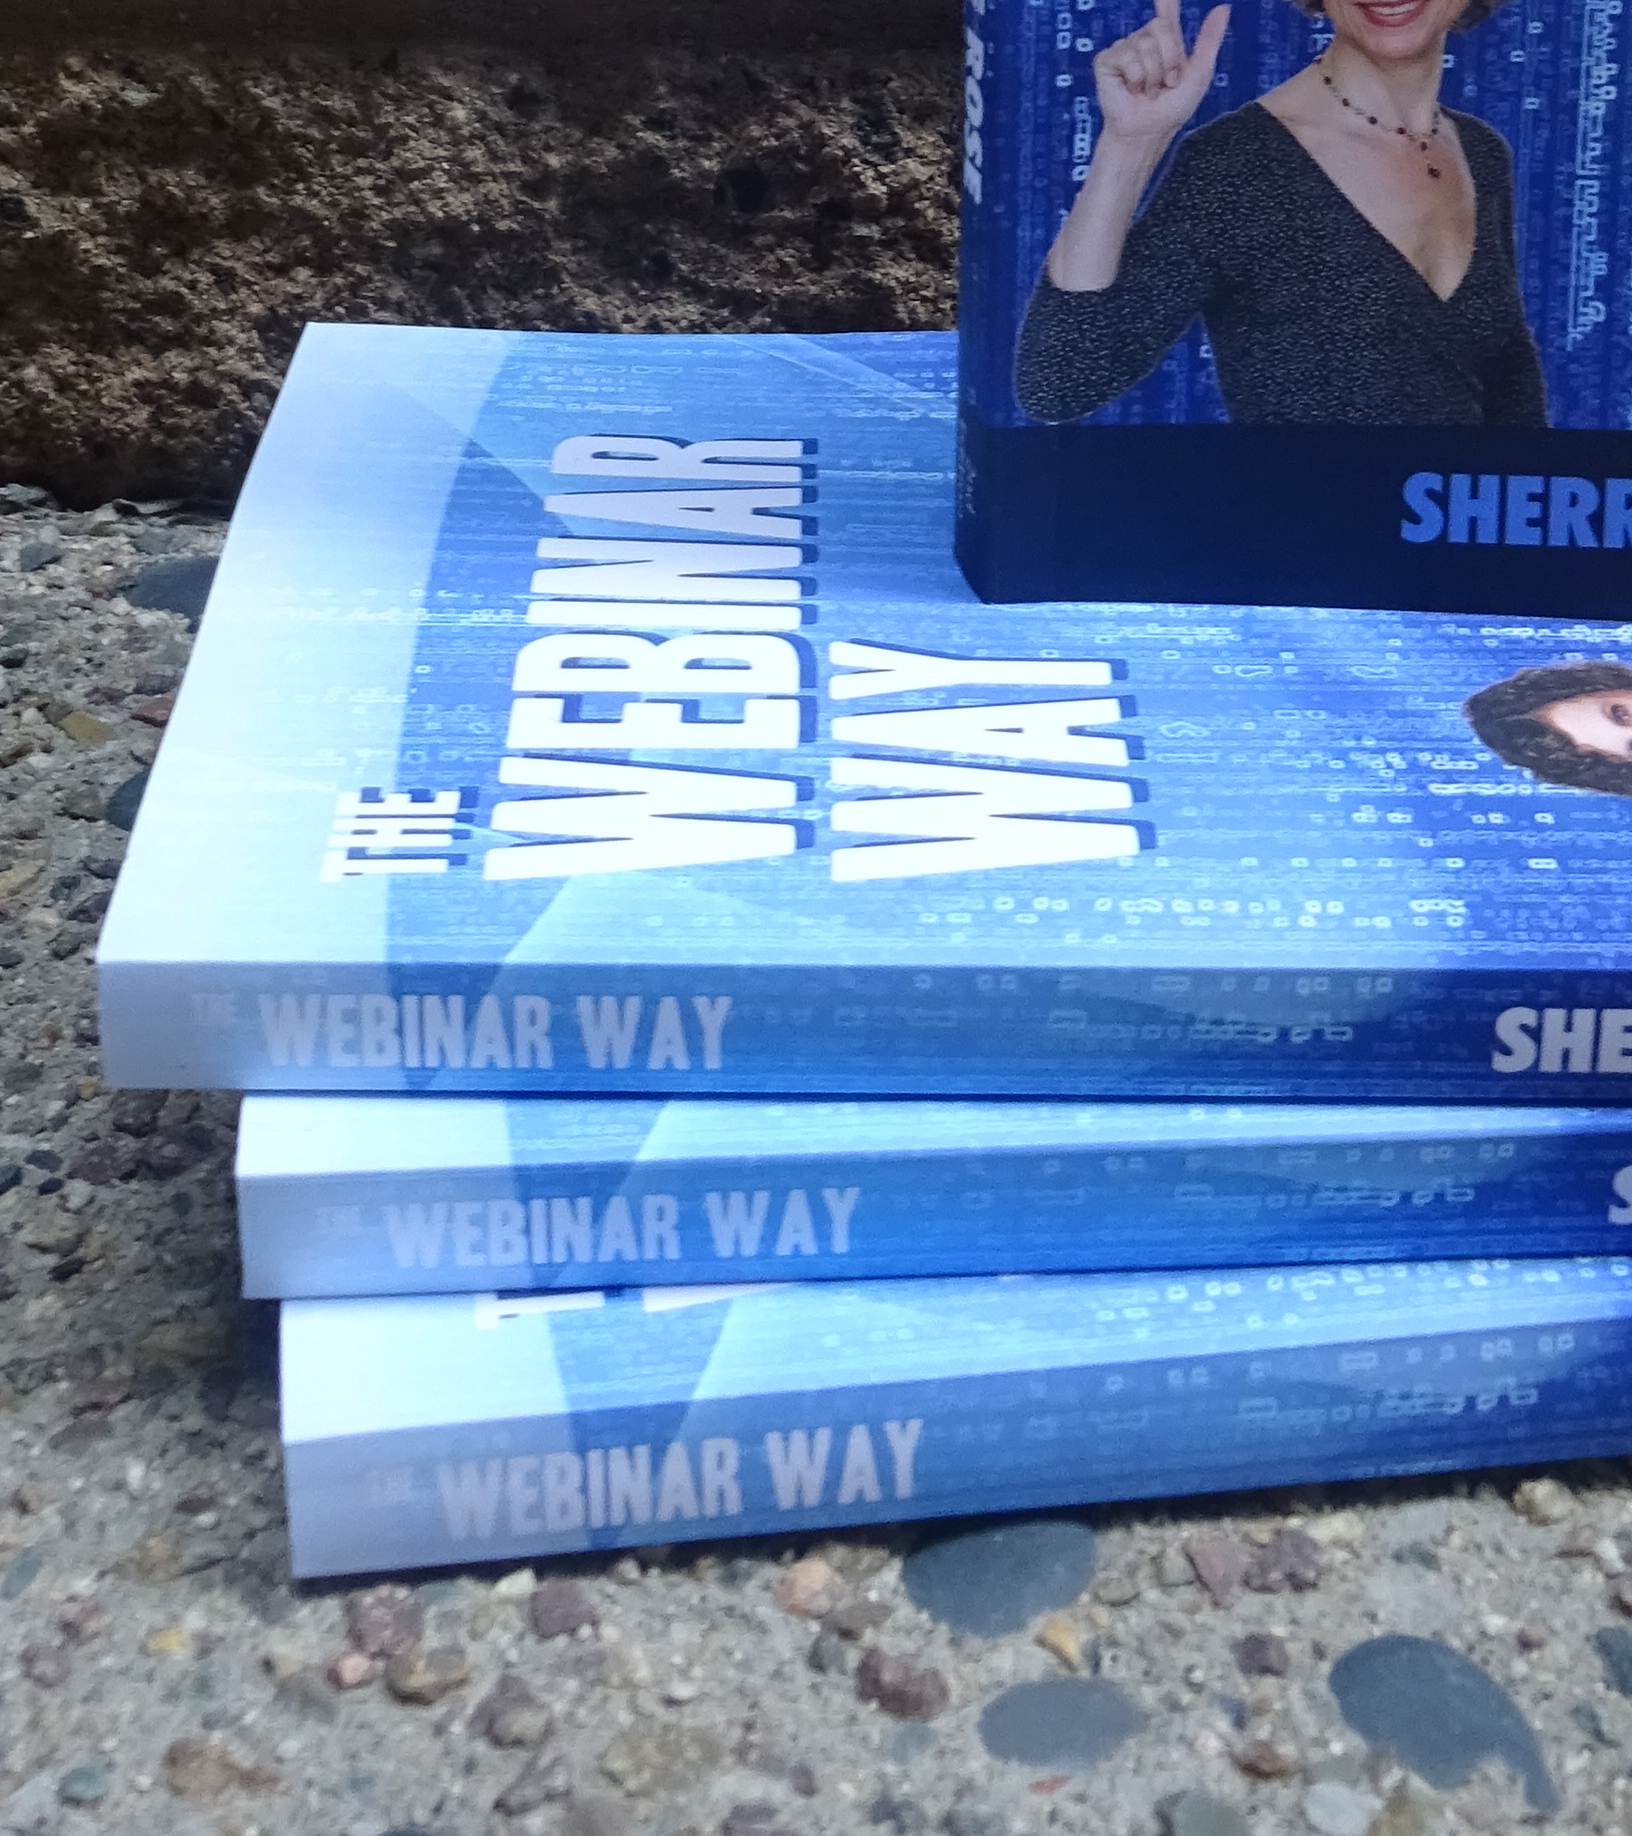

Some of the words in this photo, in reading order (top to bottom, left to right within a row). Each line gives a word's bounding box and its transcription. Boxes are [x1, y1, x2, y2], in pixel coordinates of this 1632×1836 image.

[964, 28, 985, 205] ROSE
[483, 433, 805, 881] WEBINAR
[829, 638, 1142, 883] WAY
[319, 786, 461, 883] THE
[257, 992, 554, 1070] WEBINAR
[576, 994, 735, 1071] WAY
[383, 1193, 682, 1270] WEBINAR
[706, 1186, 862, 1259] WAY
[436, 1435, 744, 1543] WEBINAR
[768, 1417, 927, 1513] WAY
